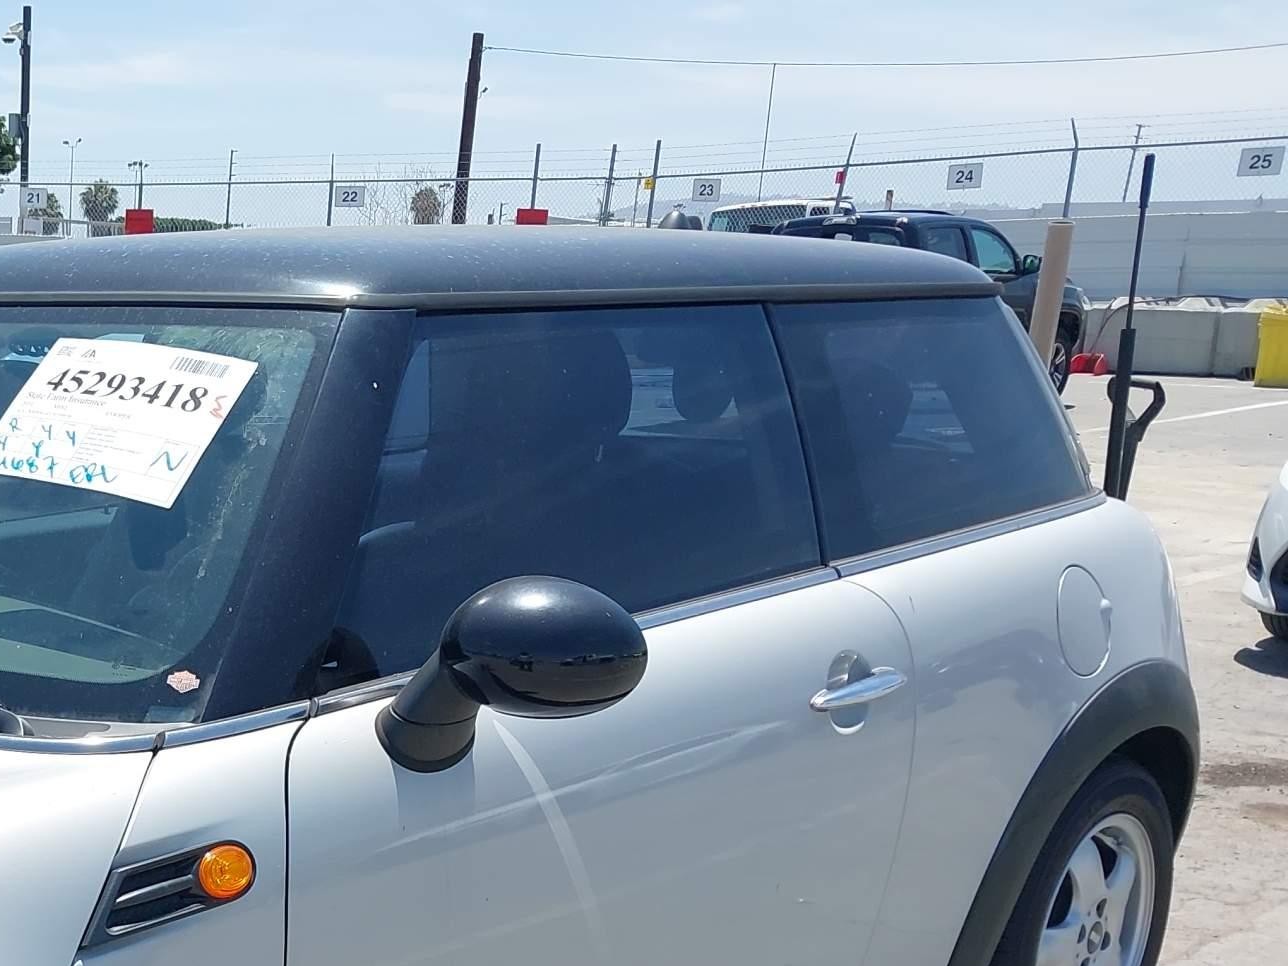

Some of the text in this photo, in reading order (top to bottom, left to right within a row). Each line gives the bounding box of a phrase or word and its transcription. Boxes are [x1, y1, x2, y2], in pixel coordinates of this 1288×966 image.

[1249, 154, 1273, 169] 25
[955, 169, 974, 183] 24
[342, 190, 358, 202] 22
[699, 183, 714, 196] 23
[27, 192, 41, 204] 21
[46, 368, 209, 412] 45293418
